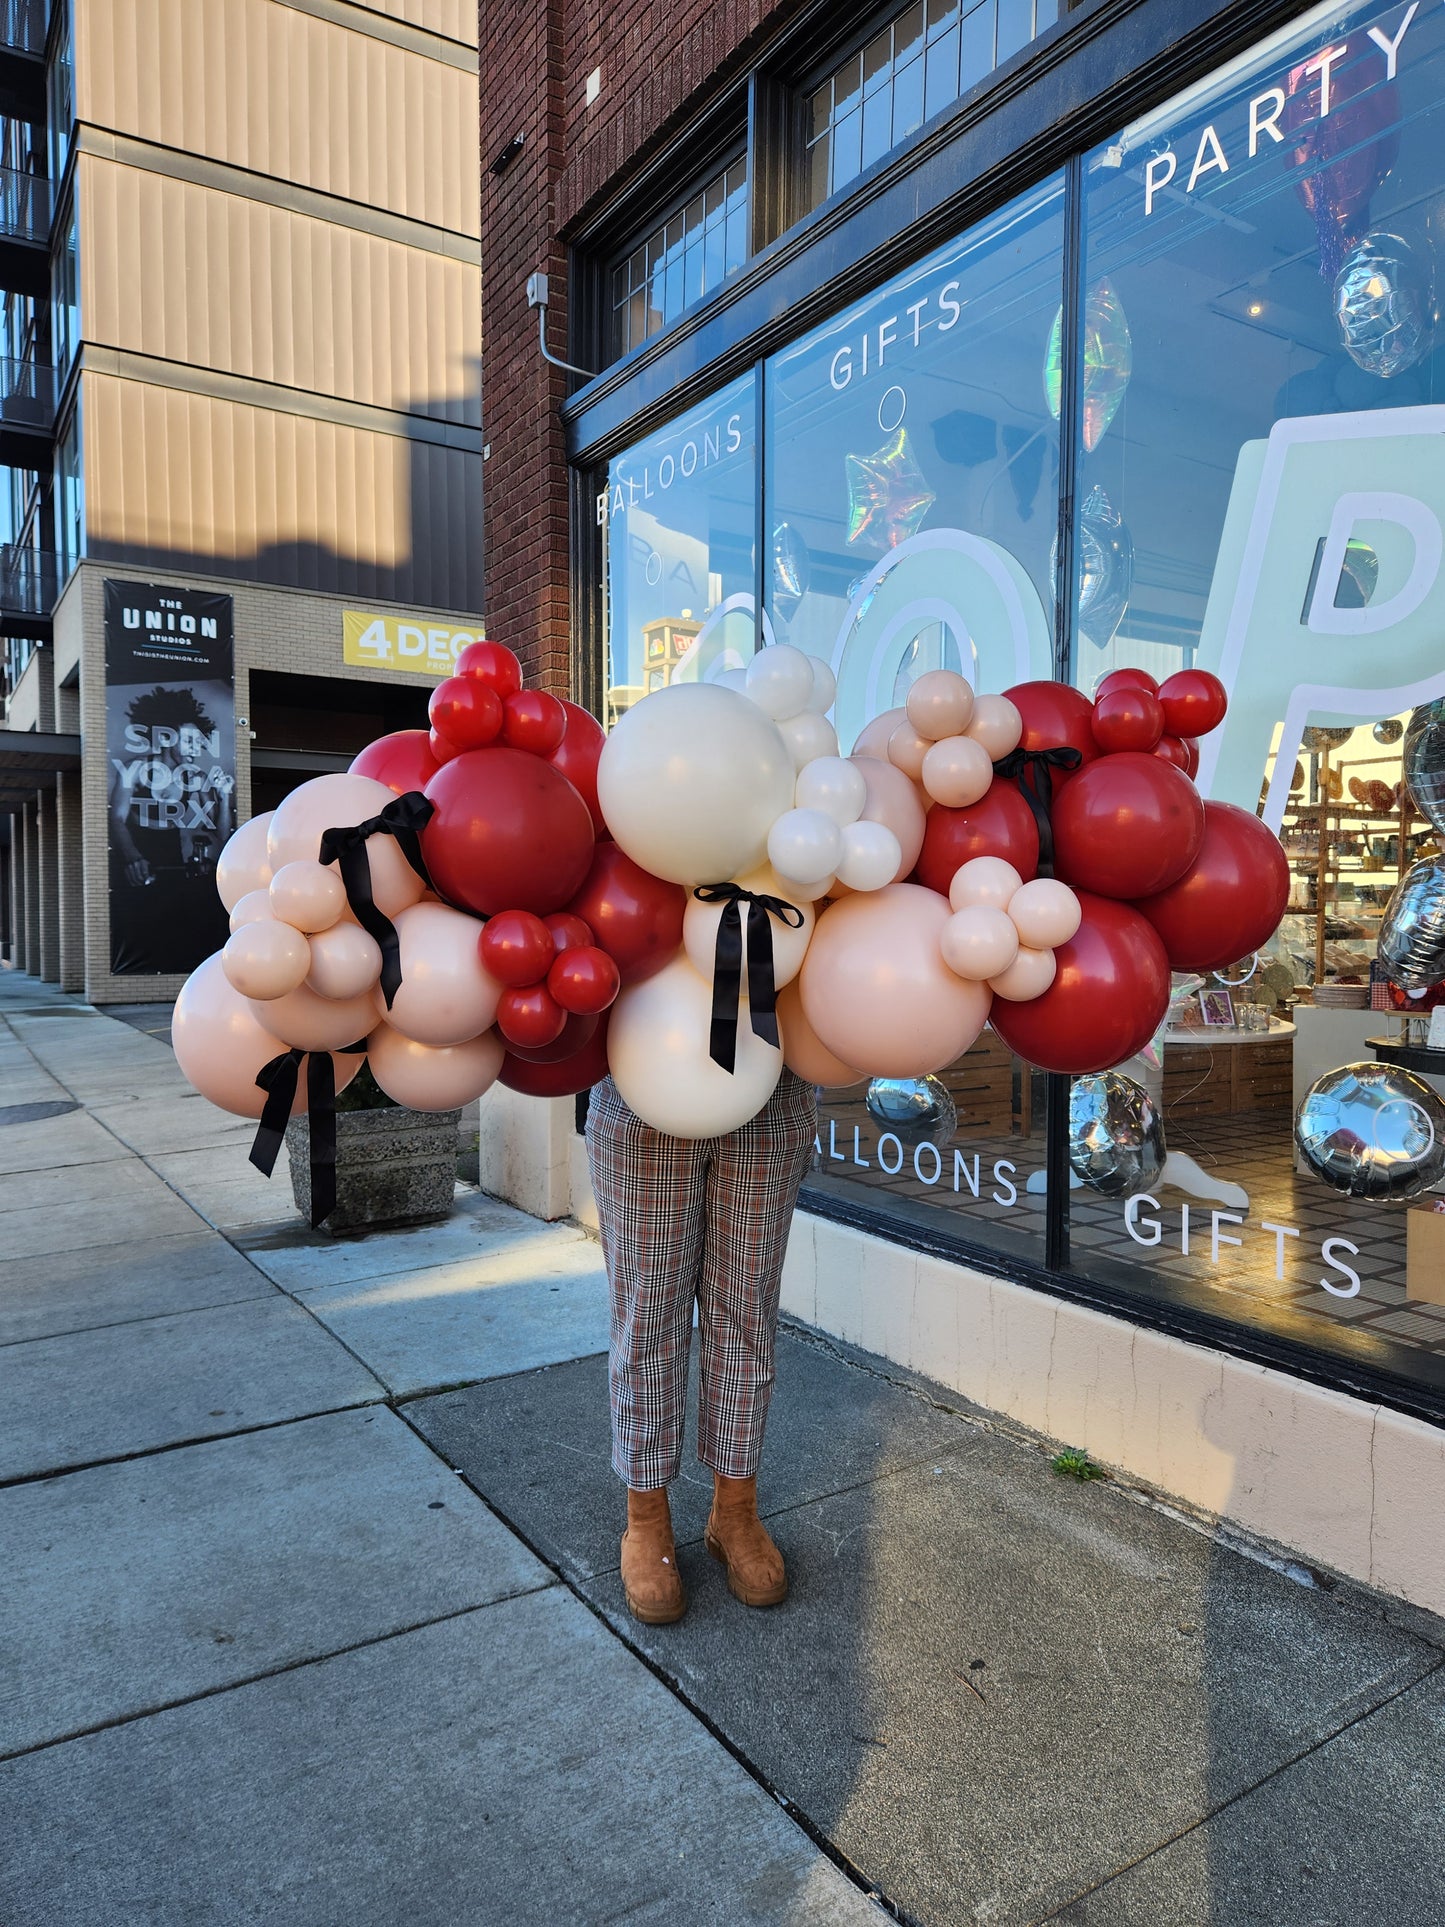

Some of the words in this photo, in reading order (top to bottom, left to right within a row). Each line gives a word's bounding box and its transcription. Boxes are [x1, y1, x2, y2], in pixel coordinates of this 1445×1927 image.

[1143, 0, 1420, 216] PARTY
[829, 280, 962, 392] GIFTS
[596, 414, 741, 527] BALLOONS
[159, 598, 183, 610] THE
[122, 607, 217, 639] UNION
[149, 634, 192, 646] STUDIOS
[358, 620, 392, 658] 4
[398, 624, 486, 661] DEG
[132, 650, 210, 664] THISISTHEUNION.COM
[124, 723, 220, 758] SPIN
[111, 759, 233, 794] YOGA
[129, 797, 216, 830] TRX
[1123, 1192, 1362, 1300] GIFTS
